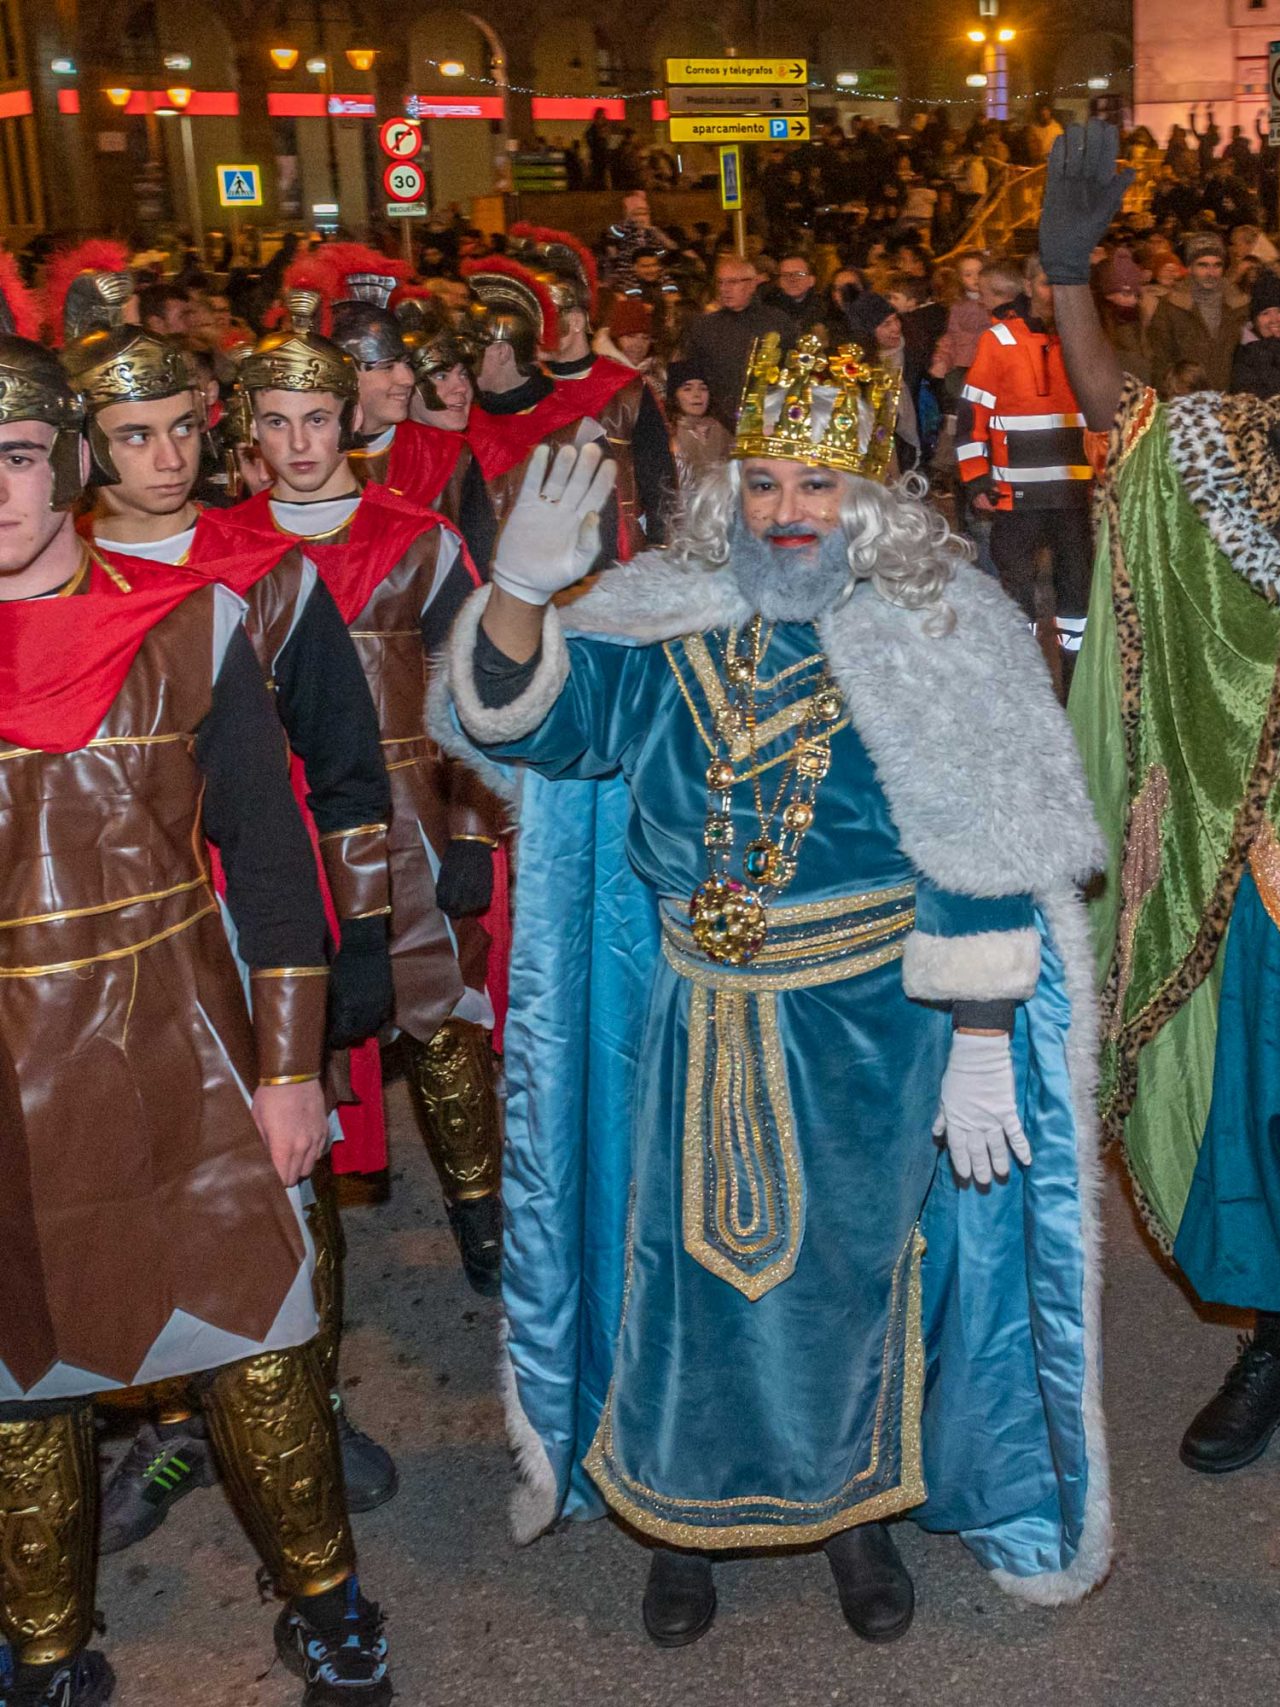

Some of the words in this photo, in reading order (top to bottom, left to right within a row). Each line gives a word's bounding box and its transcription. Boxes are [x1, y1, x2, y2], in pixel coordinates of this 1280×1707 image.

[685, 65, 720, 75] Correos
[723, 67, 728, 76] y
[692, 122, 765, 135] aparcamiento
[393, 174, 417, 189] 30
